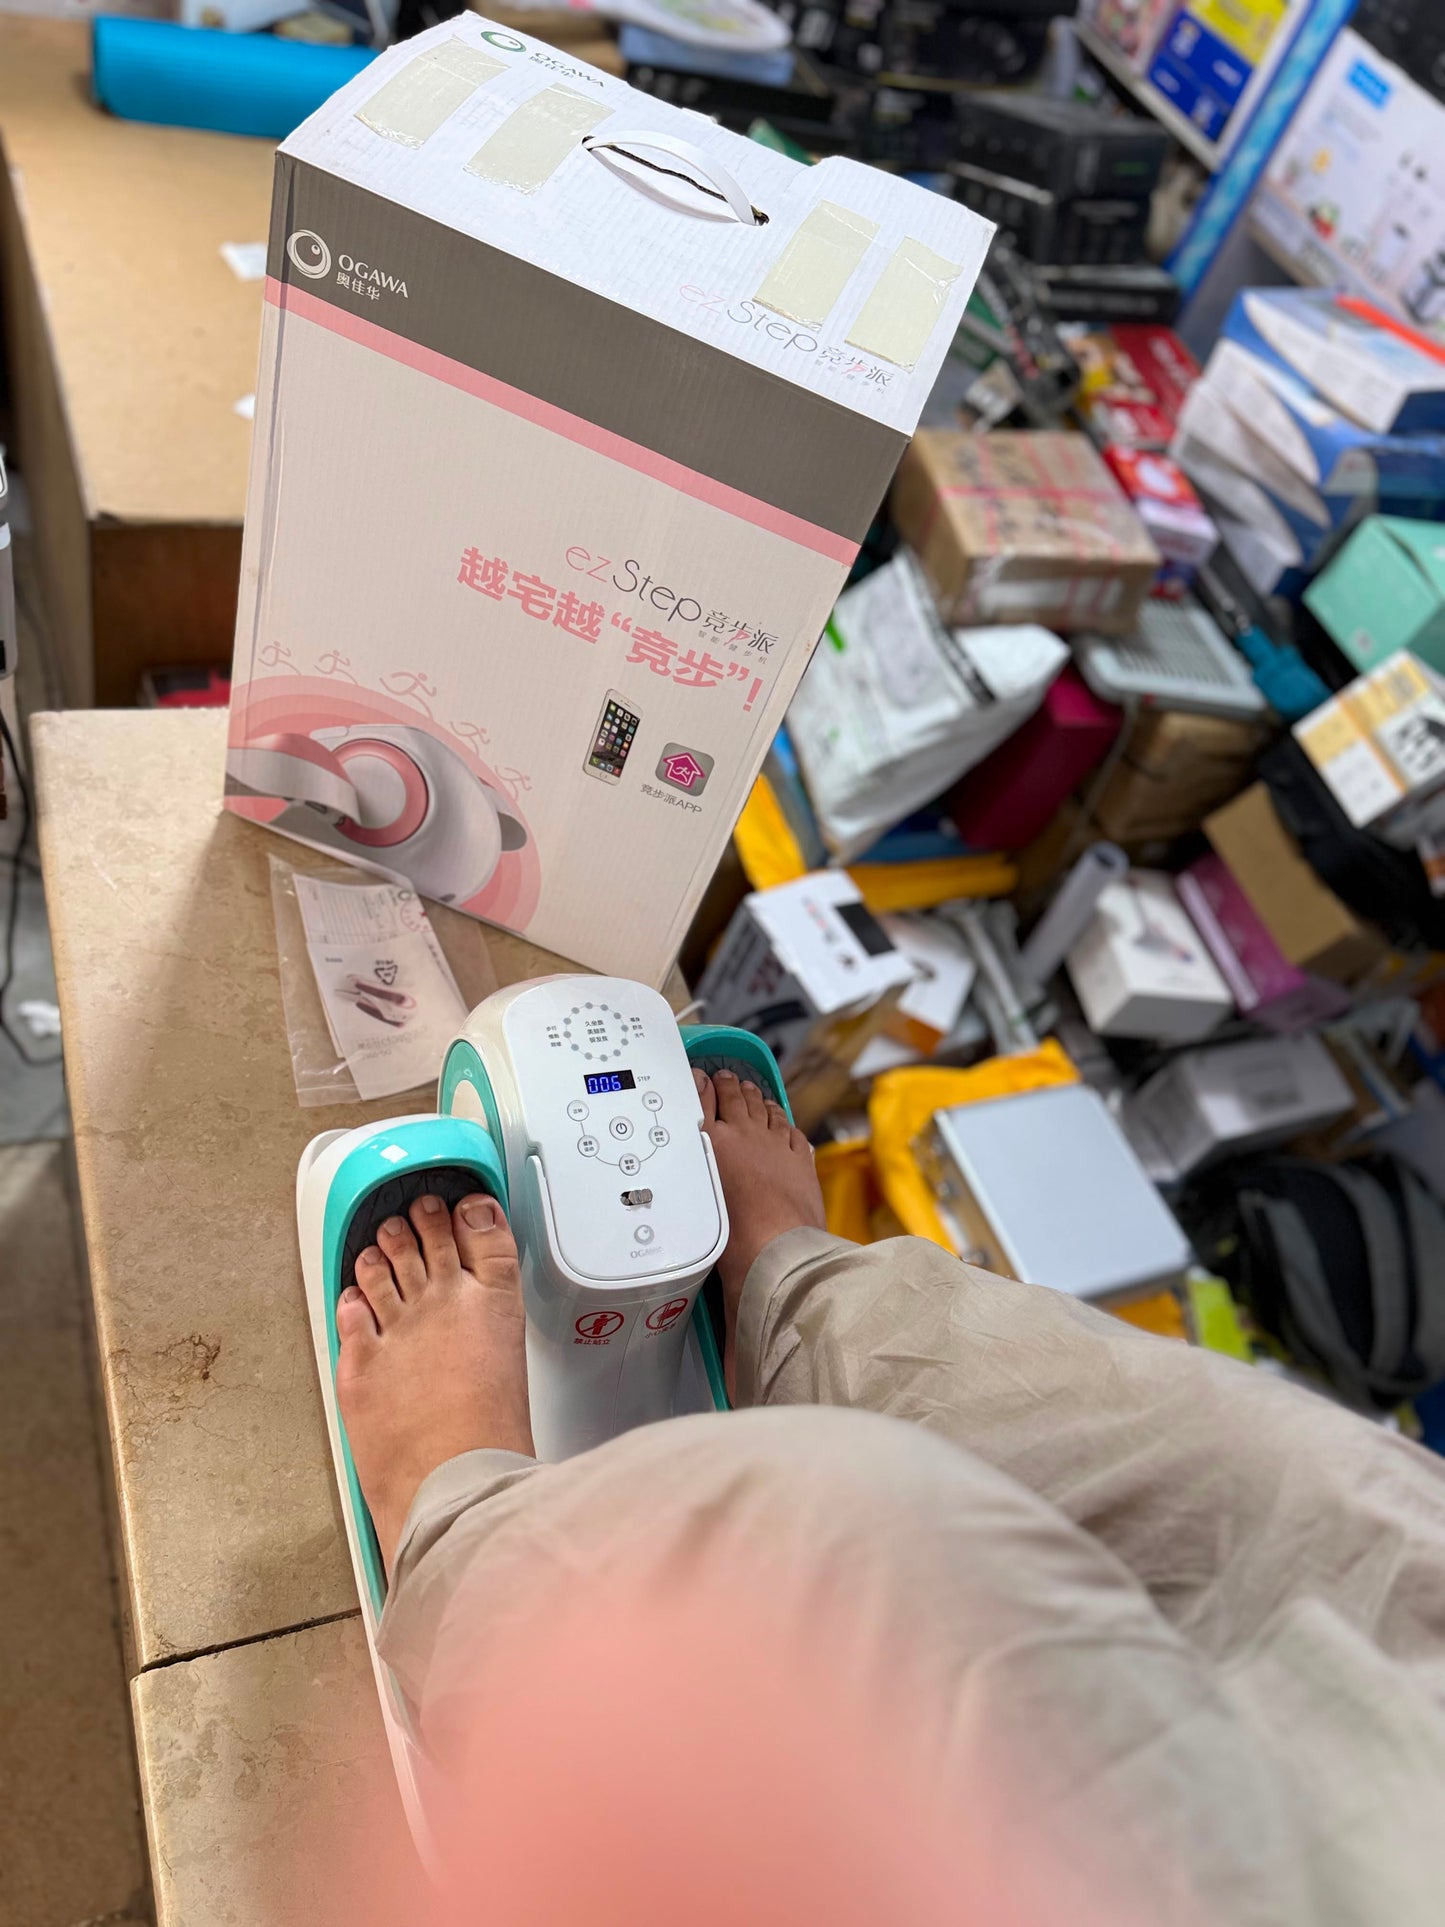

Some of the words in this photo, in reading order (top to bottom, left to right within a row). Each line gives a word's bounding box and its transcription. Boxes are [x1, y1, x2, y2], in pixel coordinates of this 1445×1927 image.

[336, 271, 380, 300] 奥佳华
[338, 254, 408, 298] OGAWA
[588, 1074, 621, 1093] 006
